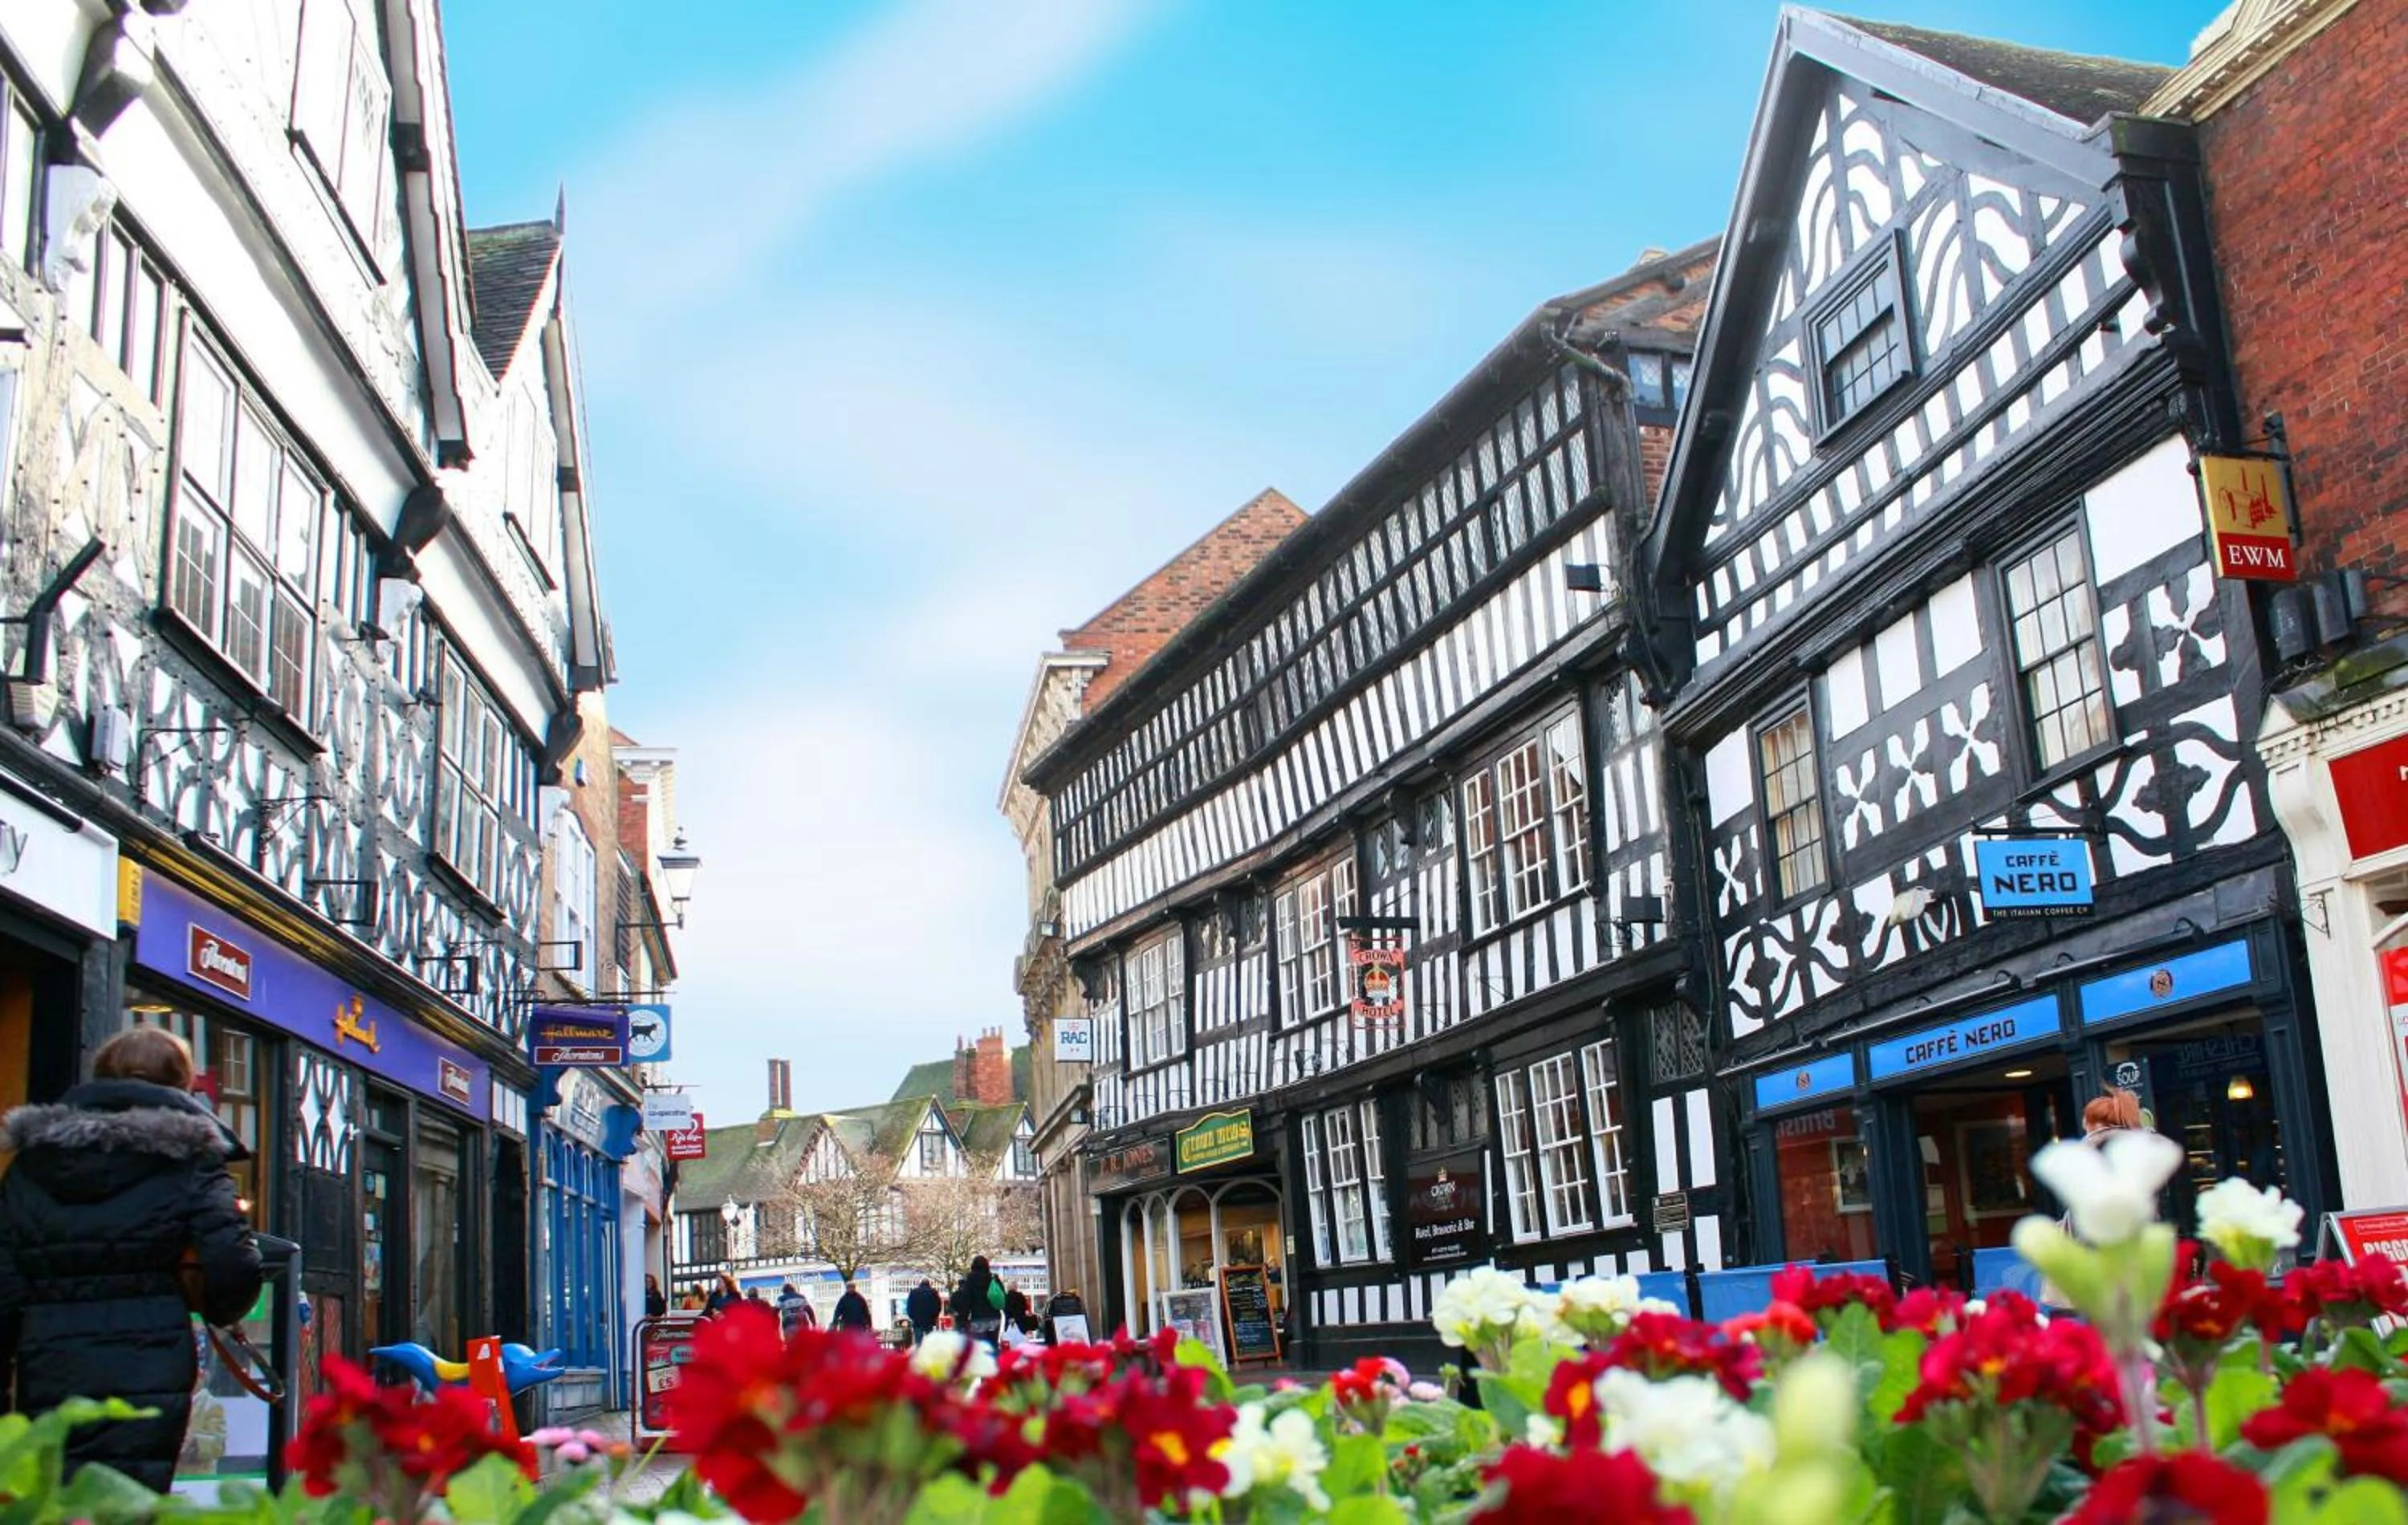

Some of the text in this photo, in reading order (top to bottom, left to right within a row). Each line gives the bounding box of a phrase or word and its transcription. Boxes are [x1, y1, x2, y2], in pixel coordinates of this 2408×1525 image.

[2227, 544, 2286, 568] EWM
[2005, 851, 2060, 868] CAFFÈ
[1994, 872, 2078, 894] NERO
[1992, 909, 2007, 918] THE
[2011, 909, 2042, 917] ITALIAN
[2044, 907, 2074, 917] COFFEE
[1358, 950, 1394, 963] CROWN
[1362, 1005, 1395, 1017] HOTEL
[1060, 1031, 1088, 1044] RAC
[1905, 1019, 2016, 1064] CAFFÈ NERO
[2116, 1068, 2141, 1086] SOUP
